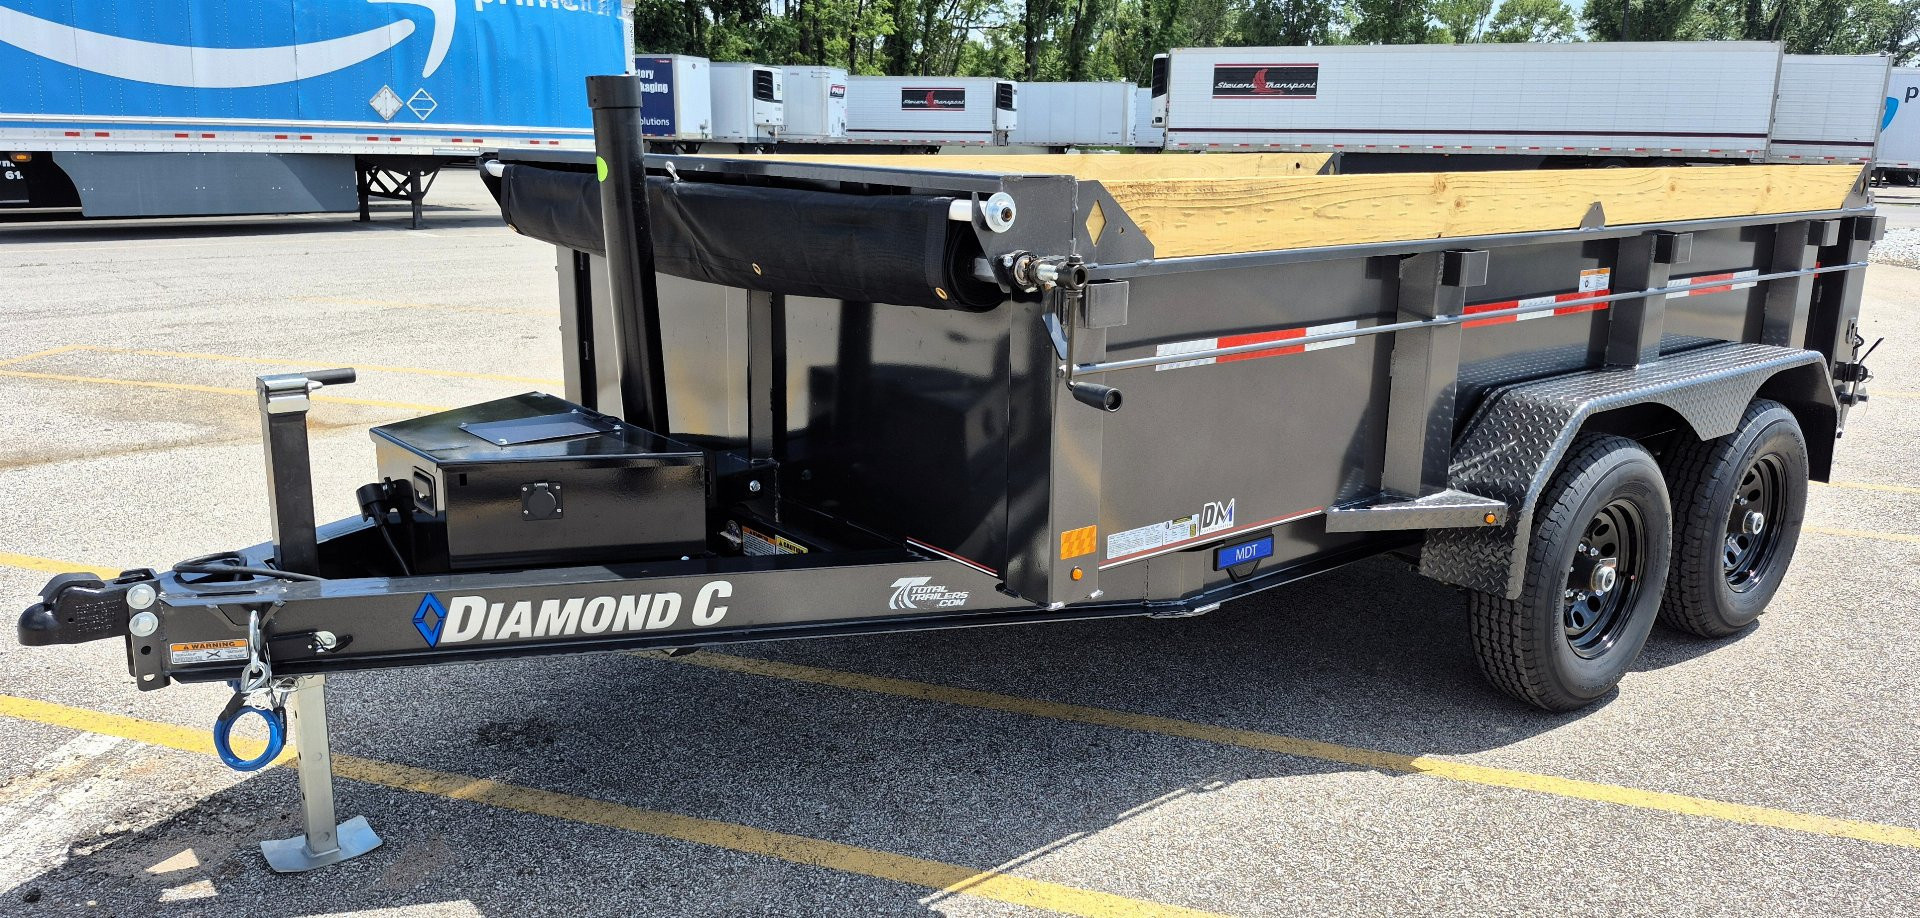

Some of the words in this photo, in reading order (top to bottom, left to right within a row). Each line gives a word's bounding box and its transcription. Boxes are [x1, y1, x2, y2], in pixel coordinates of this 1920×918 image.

[636, 69, 654, 79] tory
[640, 82, 668, 93] kaging
[1265, 82, 1316, 90] Transport
[640, 116, 670, 126] olutions
[5, 170, 24, 180] 61
[1202, 502, 1233, 528] DM
[1236, 543, 1258, 561] MDT
[912, 585, 948, 594] TOTAL
[911, 592, 969, 601] TRAILERS
[937, 599, 965, 607] .COM
[441, 592, 681, 643] DIAMOND
[692, 580, 732, 627] C
[191, 641, 235, 650] WARNING
